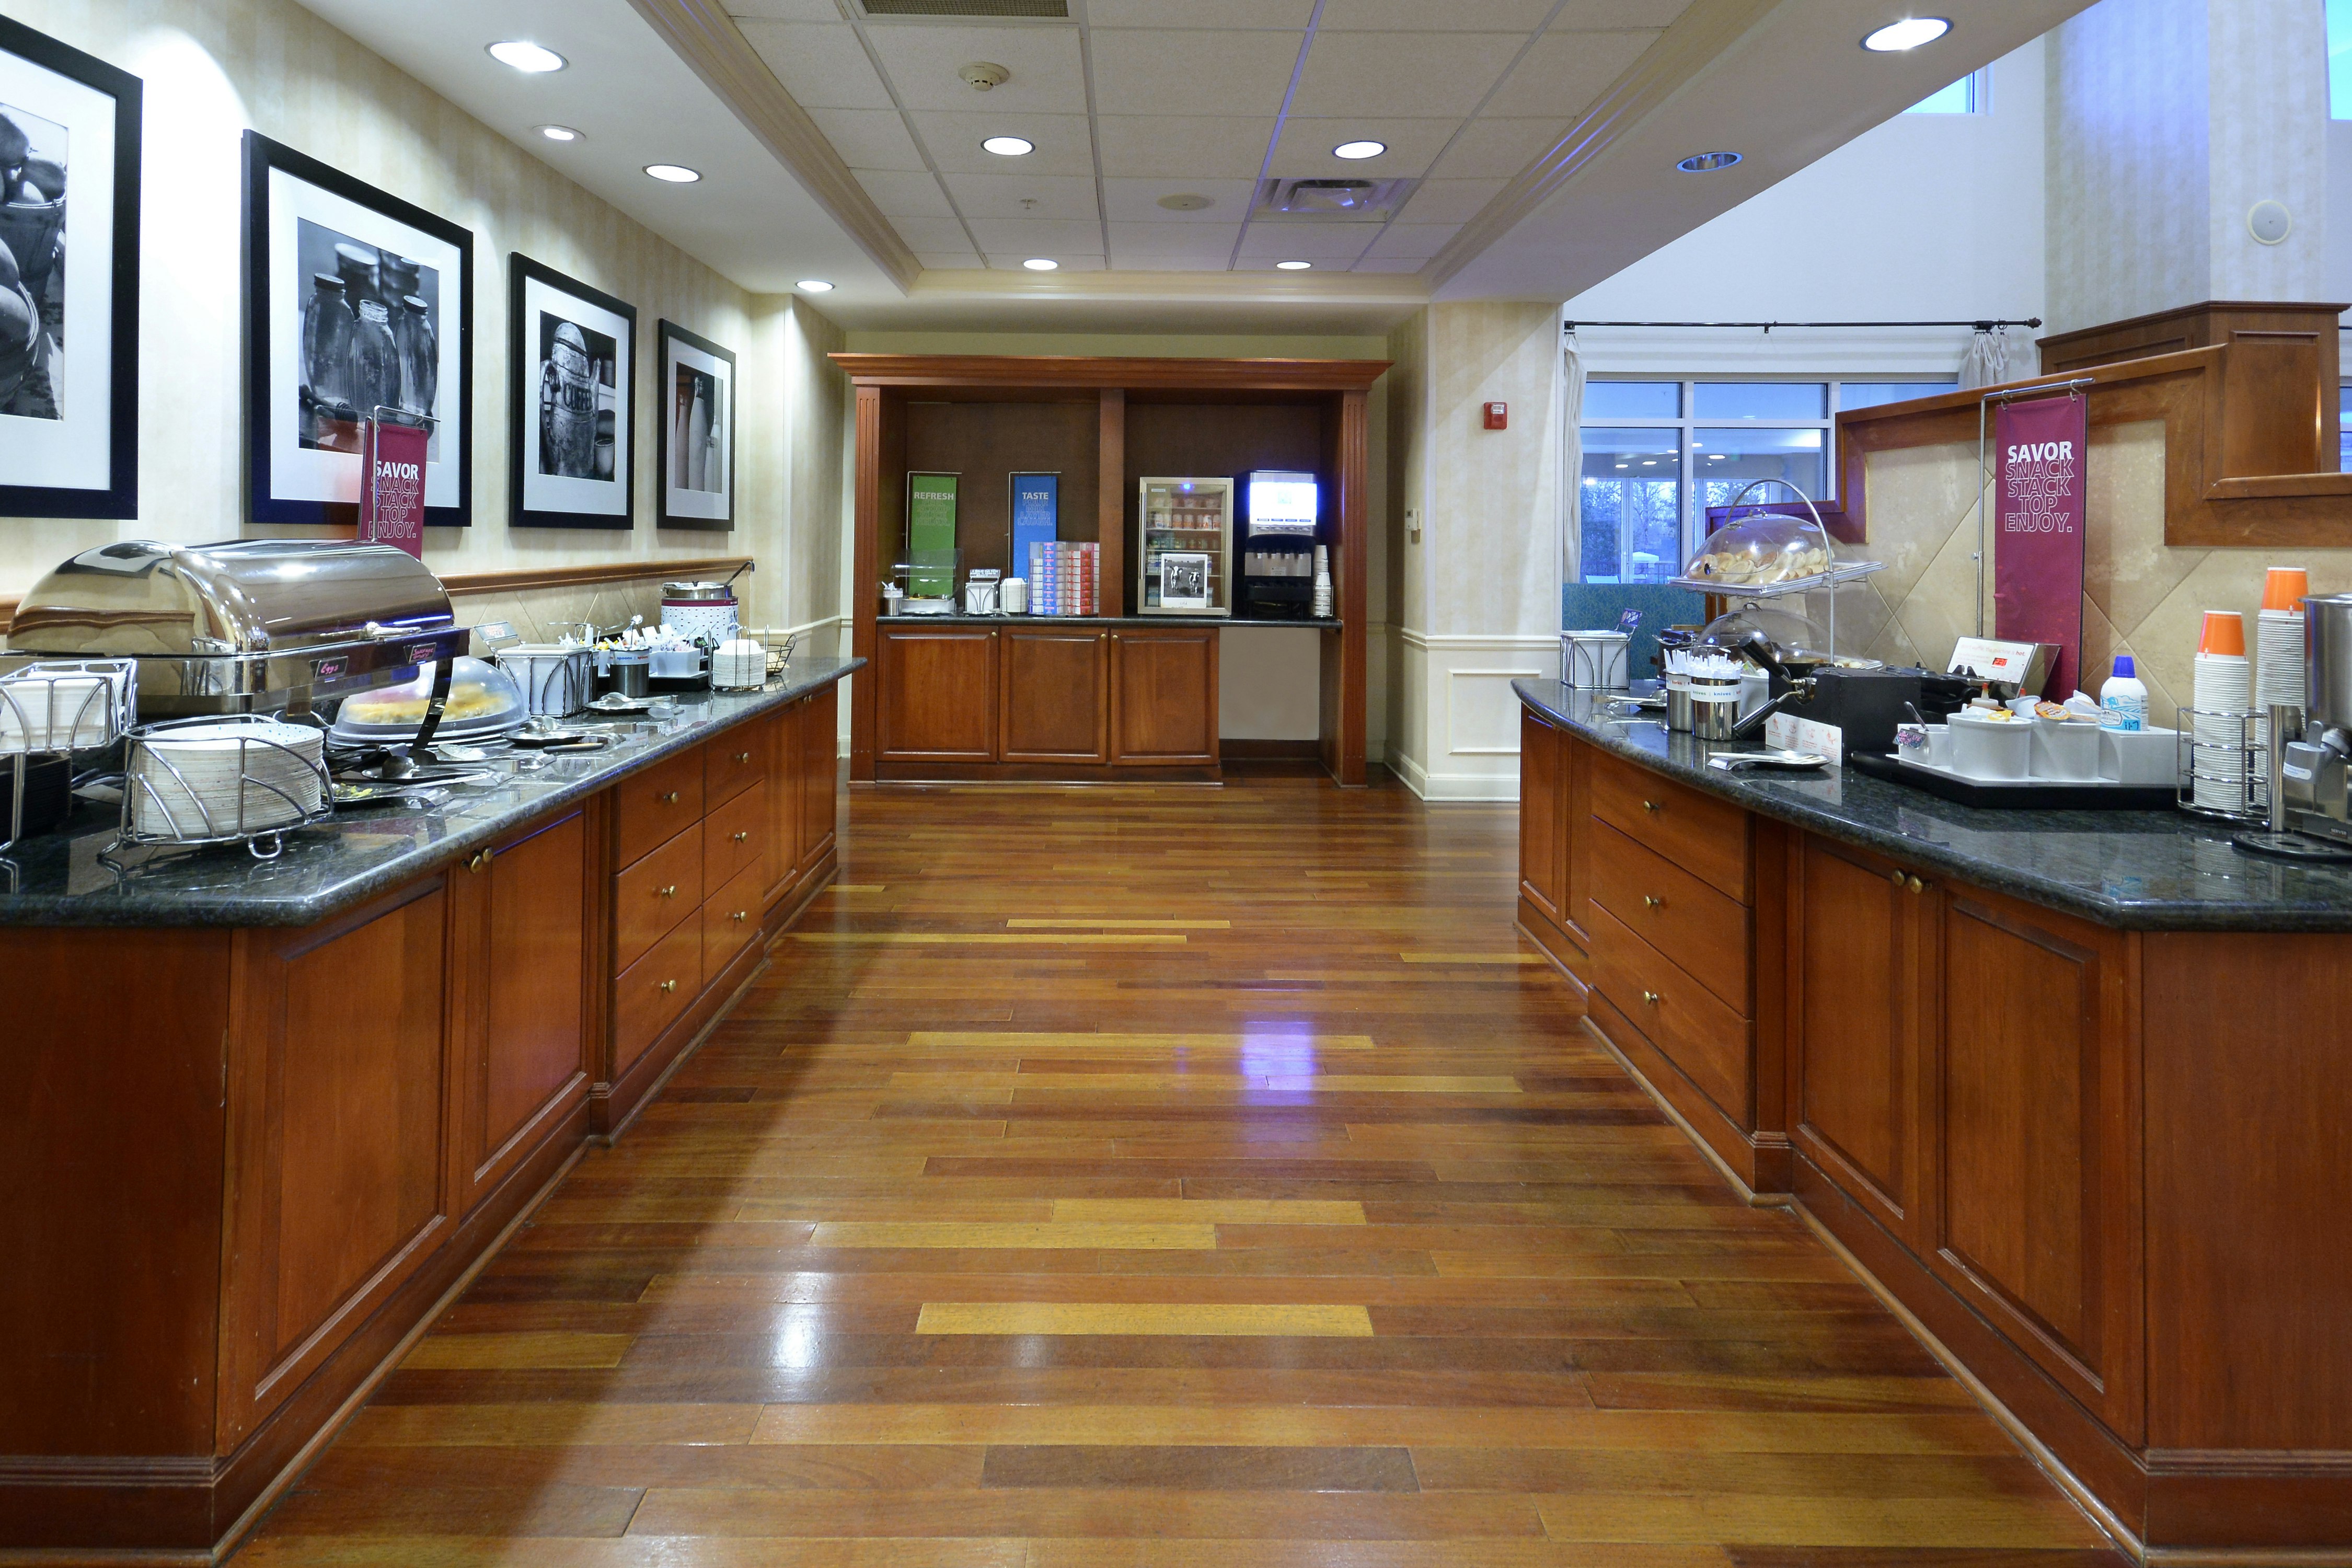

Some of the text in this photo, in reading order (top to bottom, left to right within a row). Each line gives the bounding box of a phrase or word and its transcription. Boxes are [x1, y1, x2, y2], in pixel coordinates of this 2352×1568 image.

[2008, 441, 2072, 463] SAVOR
[376, 460, 419, 479] SAVOR
[2005, 458, 2074, 480] SNACK
[371, 476, 419, 494] SNACK
[2008, 477, 2071, 497] STACK
[2019, 495, 2058, 514] TOP
[381, 507, 408, 523] TOP
[2005, 512, 2073, 532] ENJOY.
[368, 522, 417, 538] ENJOY.
[320, 663, 339, 675] Eggs
